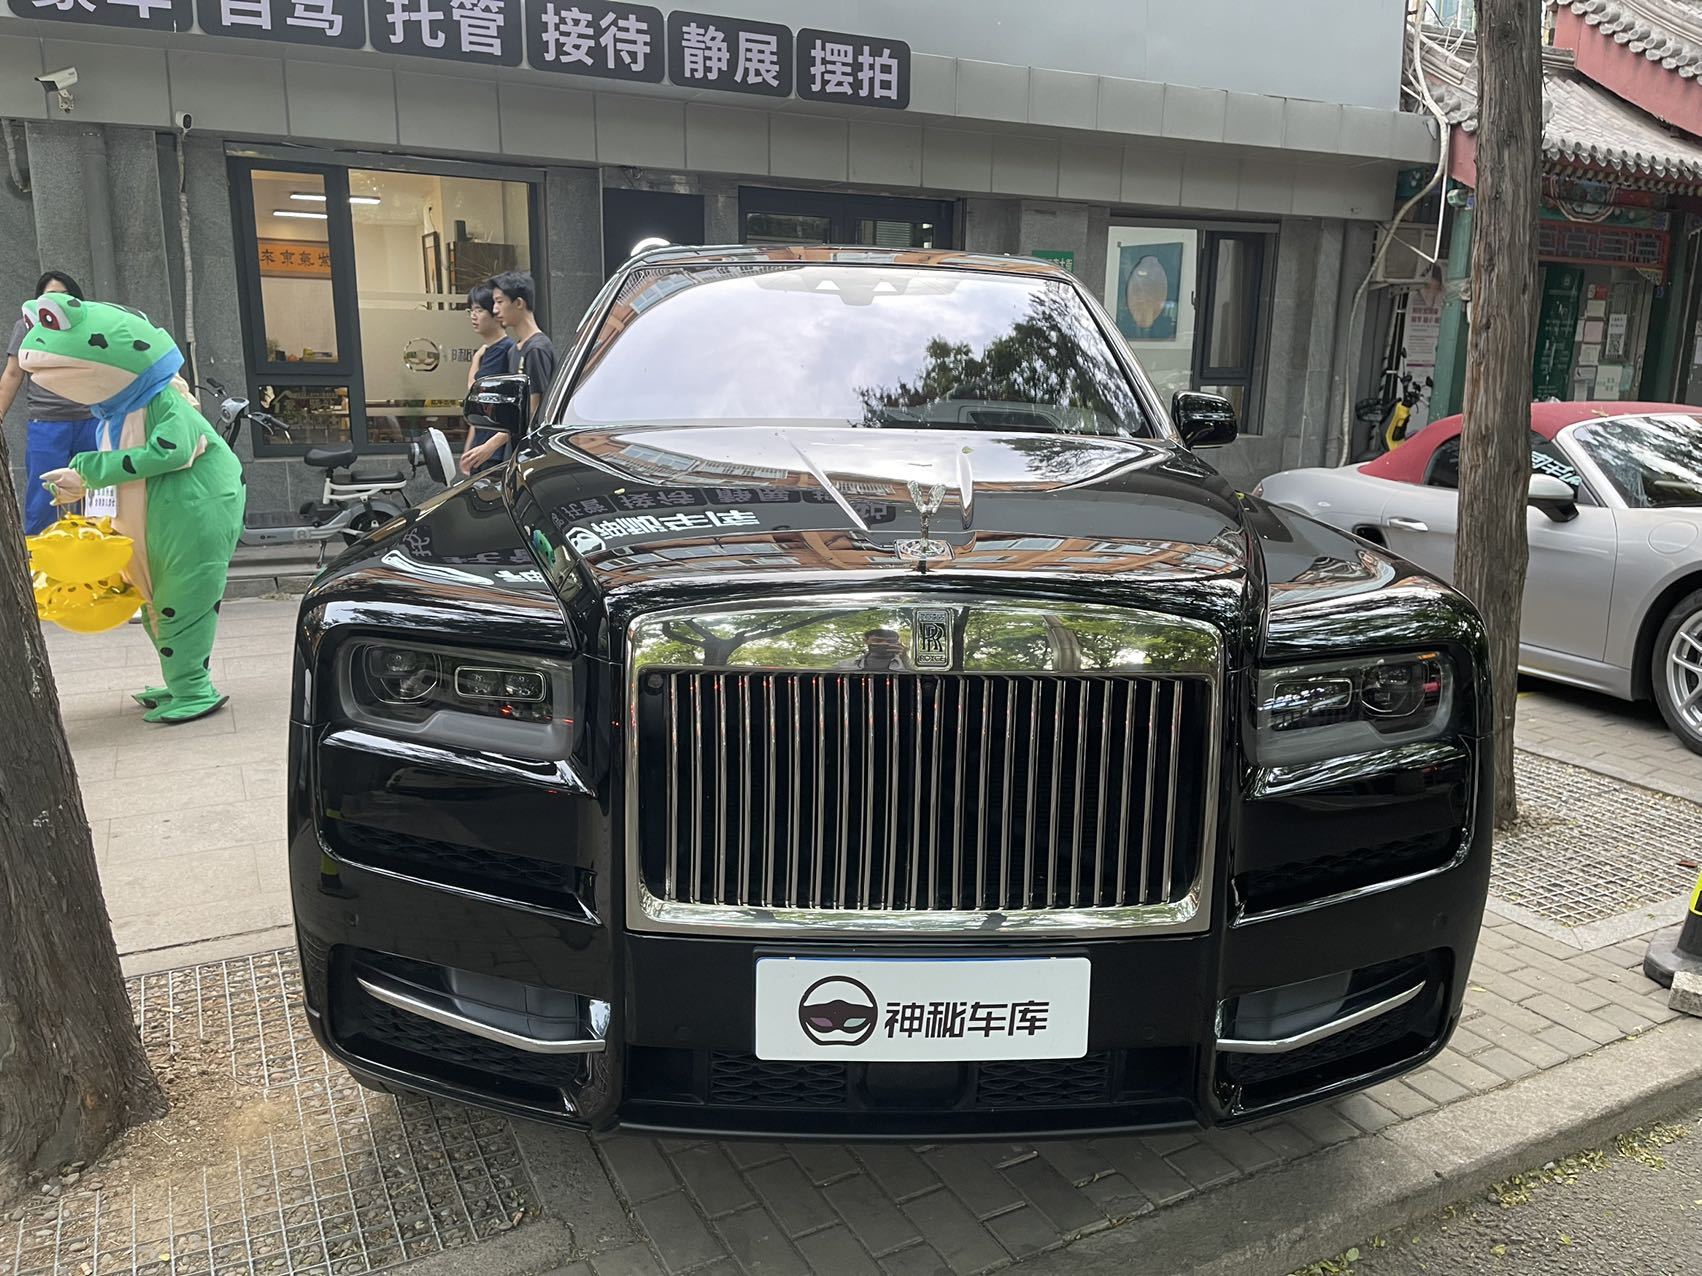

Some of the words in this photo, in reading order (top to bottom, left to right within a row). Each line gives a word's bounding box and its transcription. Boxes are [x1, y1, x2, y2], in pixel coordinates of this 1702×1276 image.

[386, 0, 504, 56] 托管
[540, 3, 652, 72] 接待
[681, 22, 781, 88] 静展
[809, 39, 899, 100] 摆拍
[884, 1000, 1050, 1038] 神秘车库
